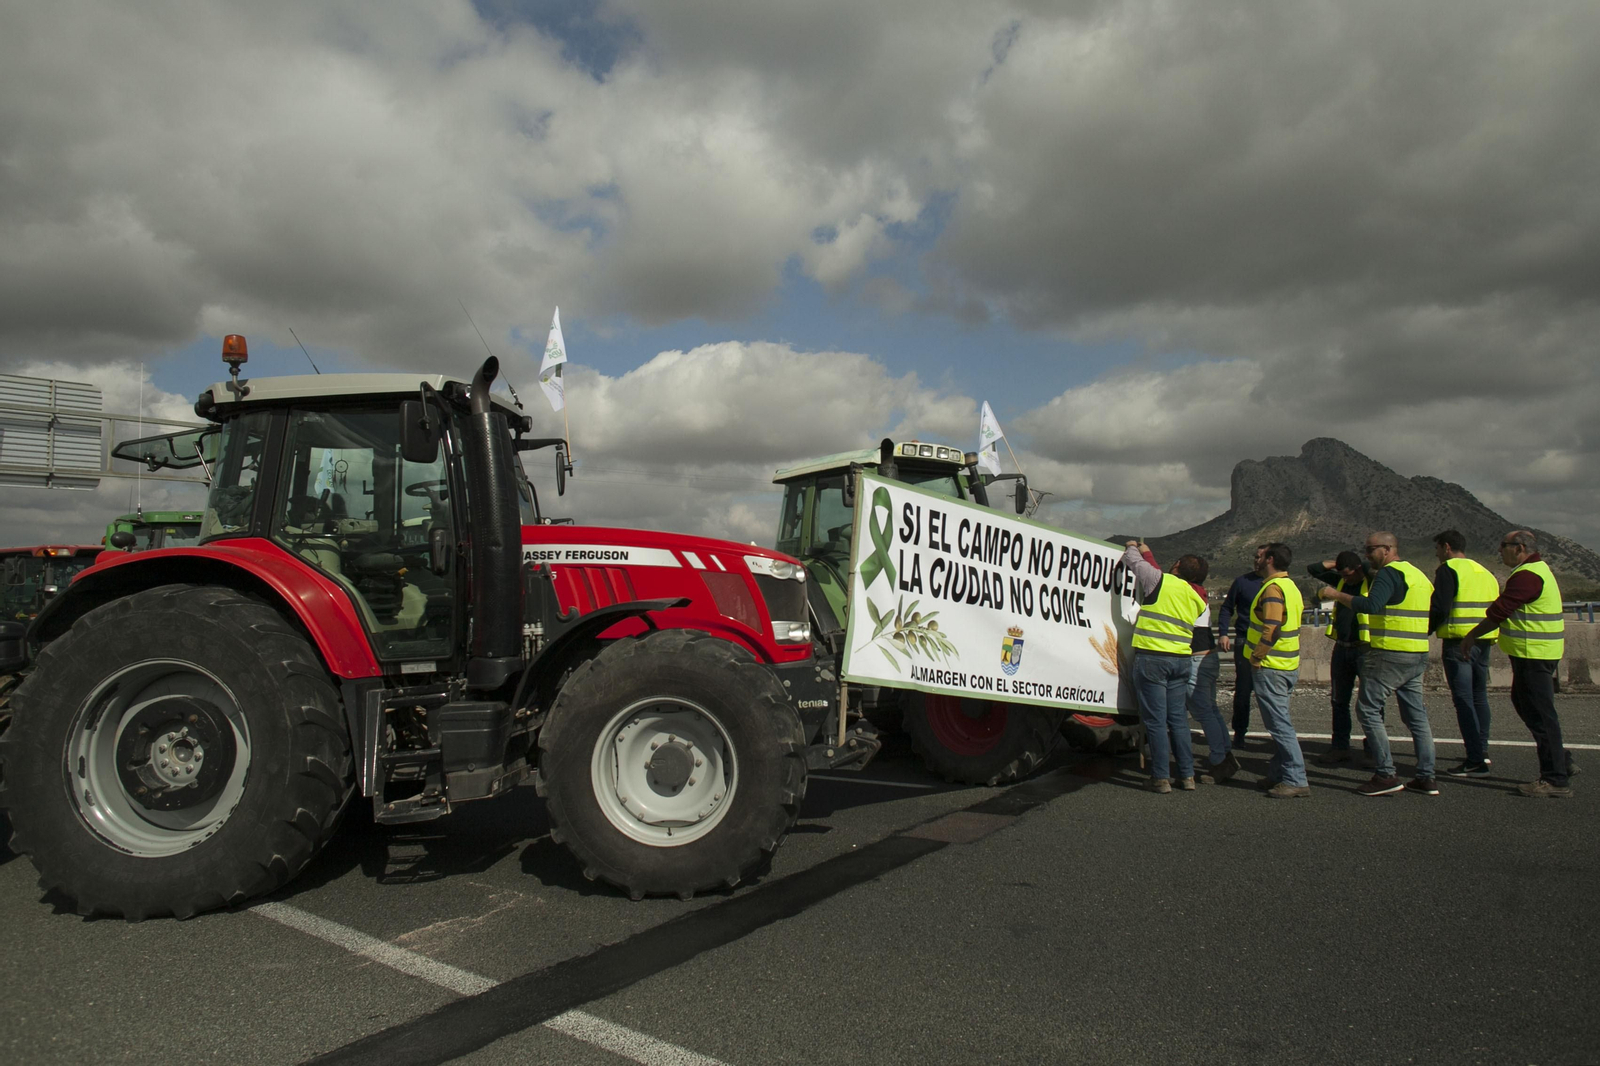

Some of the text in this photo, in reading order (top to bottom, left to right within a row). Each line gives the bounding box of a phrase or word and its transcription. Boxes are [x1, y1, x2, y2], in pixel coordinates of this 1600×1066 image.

[521, 550, 629, 560] ASSEY FERGUSON
[899, 502, 921, 545] SI
[928, 509, 951, 554] EL
[957, 518, 1023, 570] CAMPO
[1028, 537, 1054, 579] NO
[899, 549, 1092, 629] LA CIUDAD NO COME.
[910, 665, 1105, 704] ALMARGEN CON EL SECTOR AGRÍCOLA
